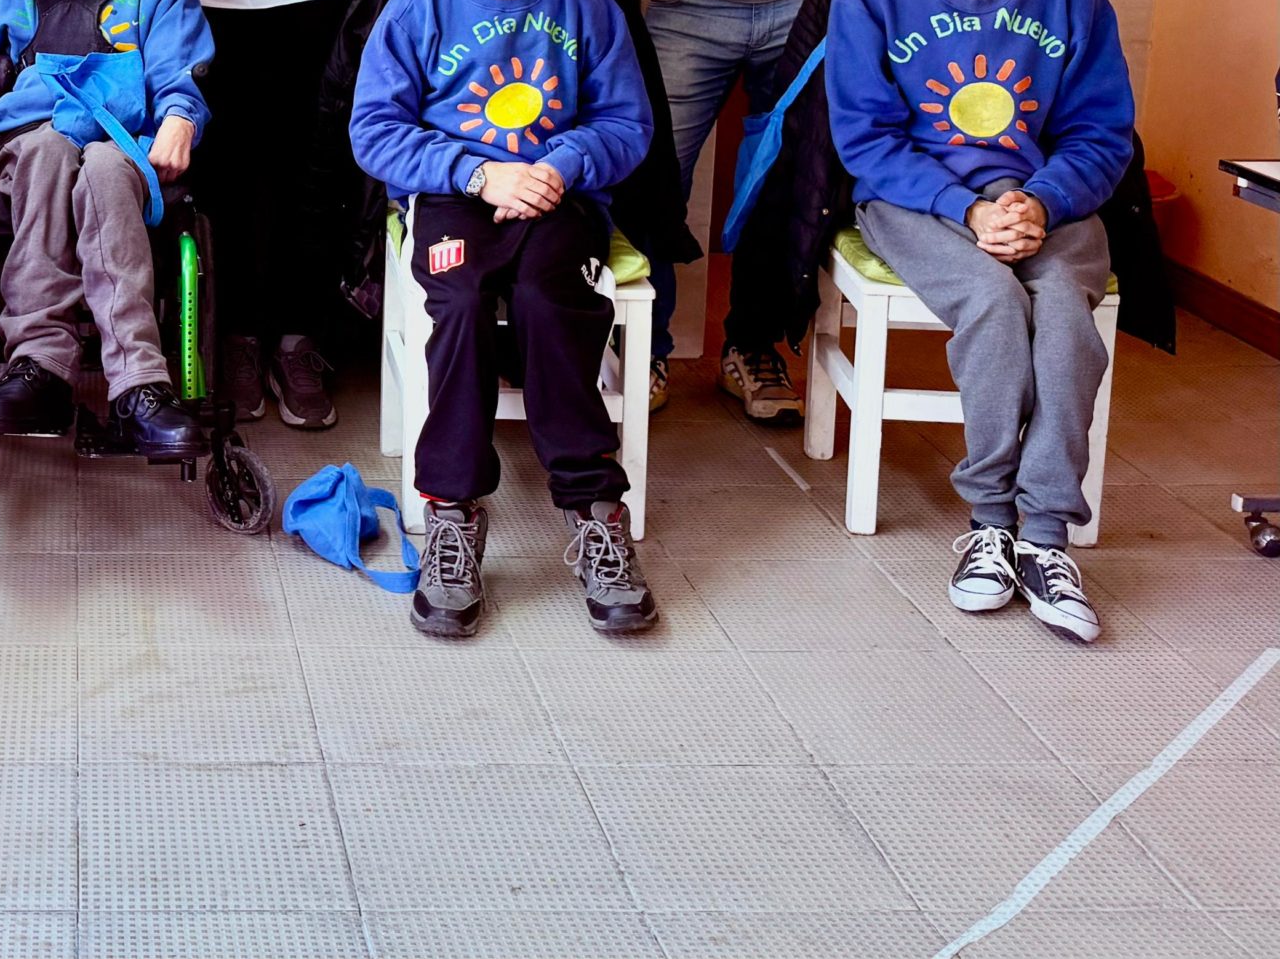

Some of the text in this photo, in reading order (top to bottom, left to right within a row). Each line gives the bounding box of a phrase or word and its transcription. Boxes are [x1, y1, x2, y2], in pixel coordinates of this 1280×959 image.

[887, 31, 928, 64] Un
[993, 6, 1066, 58] Nuevo
[438, 42, 470, 77] Un
